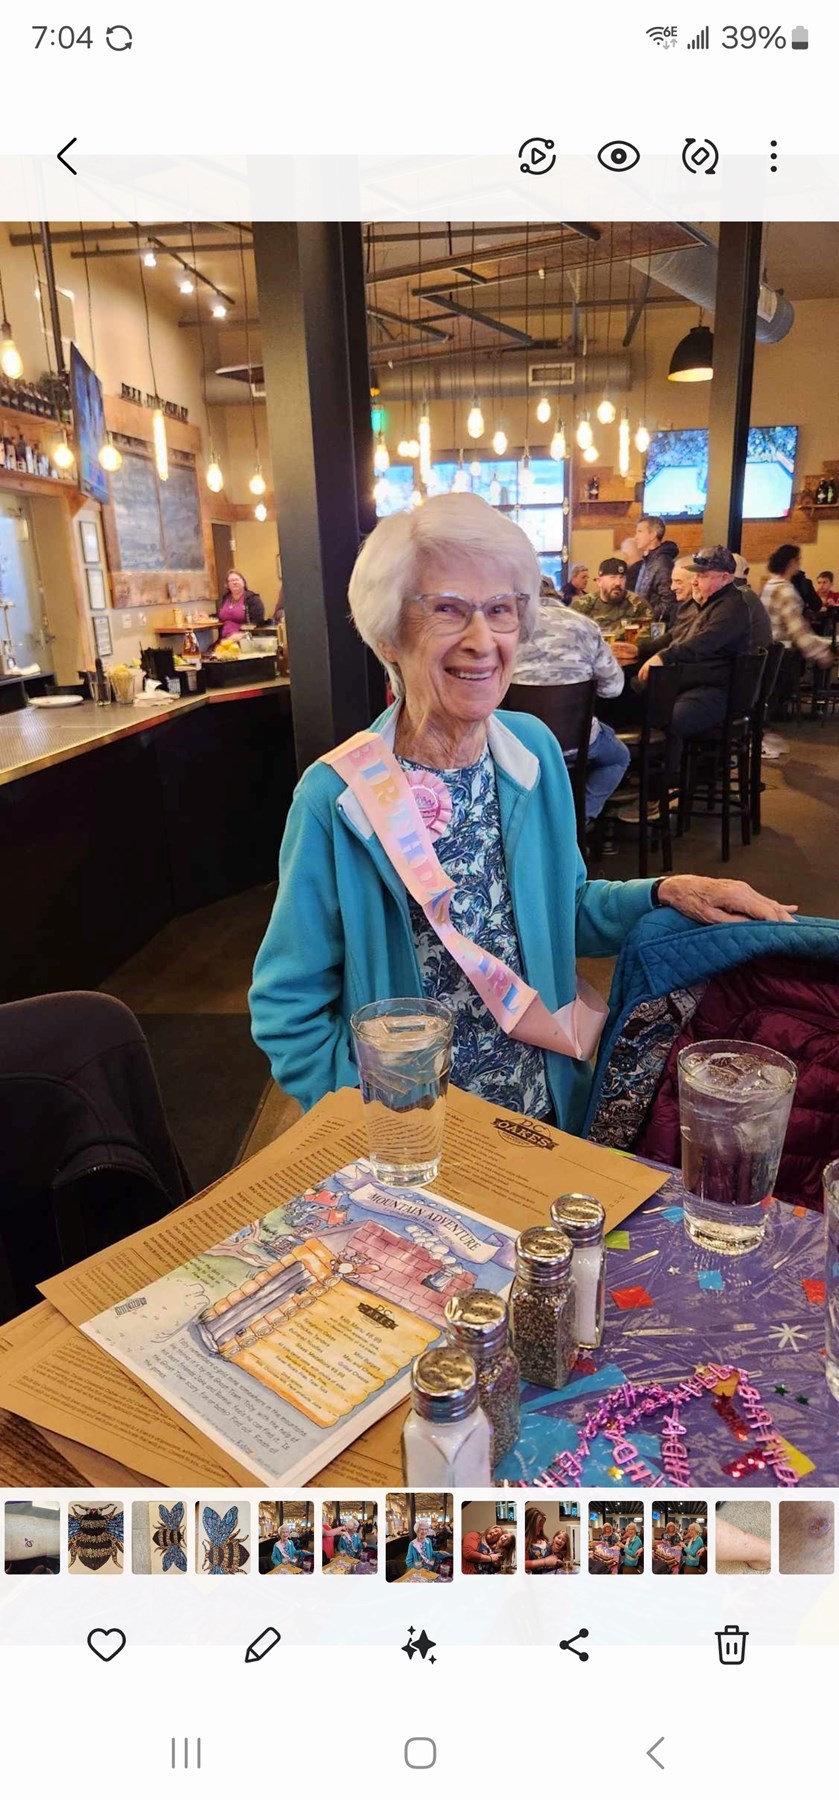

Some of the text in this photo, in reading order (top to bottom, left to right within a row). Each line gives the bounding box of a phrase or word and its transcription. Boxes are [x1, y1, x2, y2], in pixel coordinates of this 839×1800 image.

[498, 1121, 550, 1148] OAKES
[519, 1119, 546, 1132] DC
[367, 1192, 426, 1218] MOUNTAIN
[426, 1211, 481, 1252] ADVENTURE
[297, 1322, 330, 1347] Chicken Tenders
[351, 1322, 365, 1334] Menu
[353, 1370, 370, 1384] Cheese
[363, 1366, 379, 1379] Cheese
[364, 1357, 381, 1372] Burgers
[174, 1371, 187, 1382] Town
[231, 1416, 242, 1427] Find
[178, 1339, 190, 1350] Toby
[216, 1367, 228, 1379] gold
[228, 1375, 240, 1386] mine
[239, 1384, 266, 1406] somewhere
[271, 1408, 283, 1419] the
[281, 1416, 307, 1437] mountains
[214, 1377, 230, 1391] Ghost
[269, 1419, 281, 1430] the
